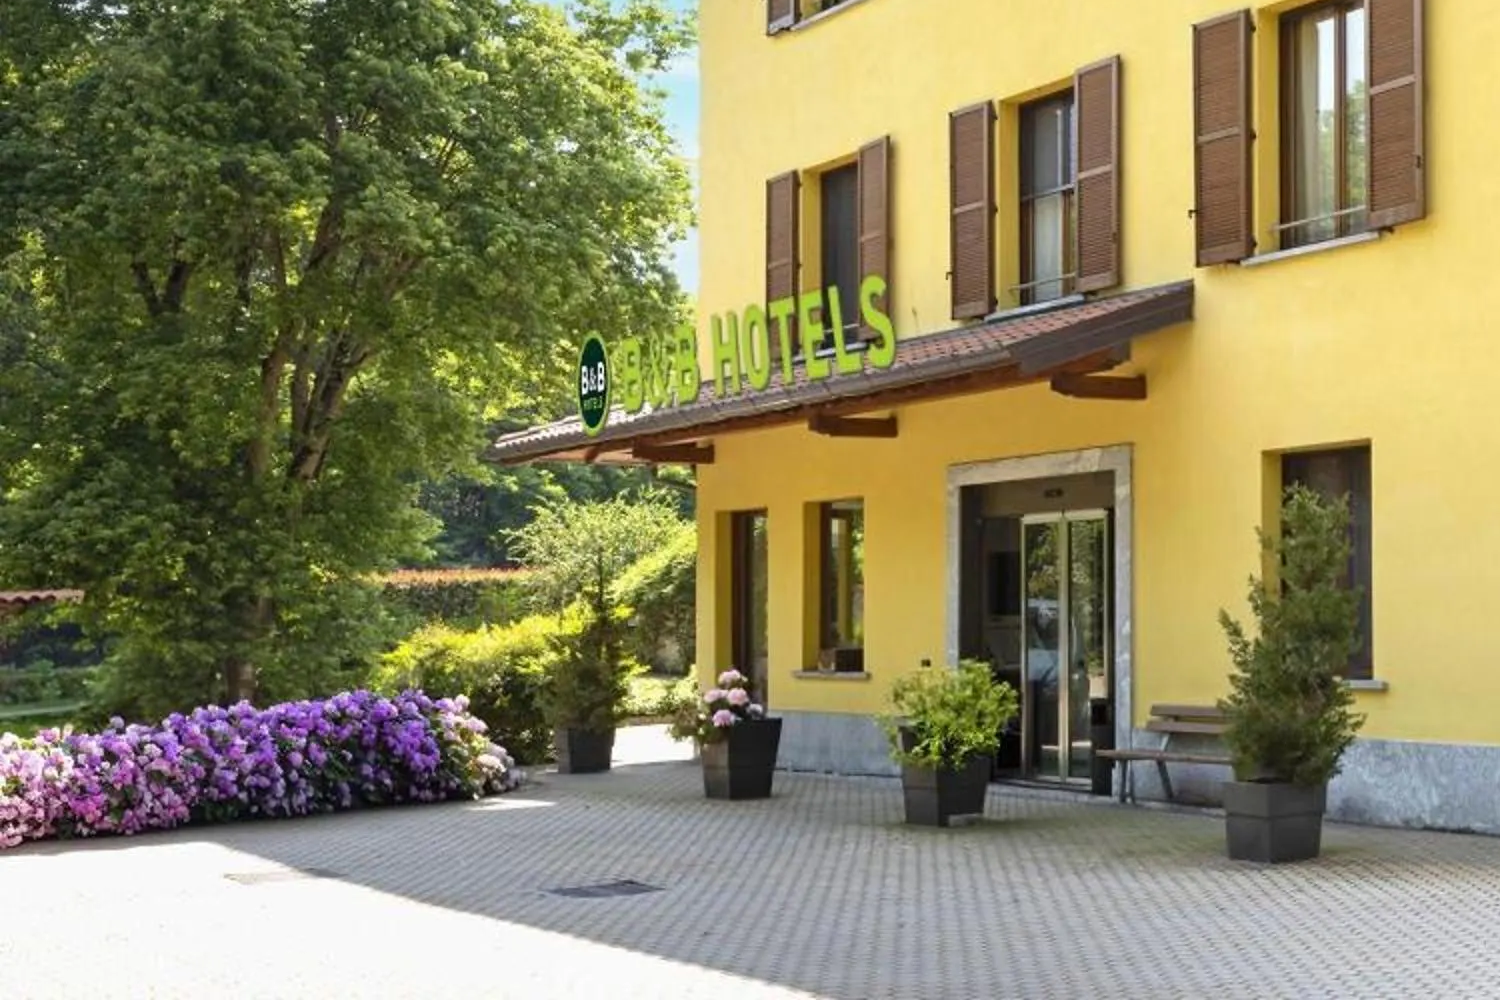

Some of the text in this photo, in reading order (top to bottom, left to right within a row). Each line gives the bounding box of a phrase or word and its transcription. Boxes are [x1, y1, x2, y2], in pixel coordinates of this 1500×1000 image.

[582, 361, 605, 394] B&B
[622, 274, 896, 413] B&B HOTELS
